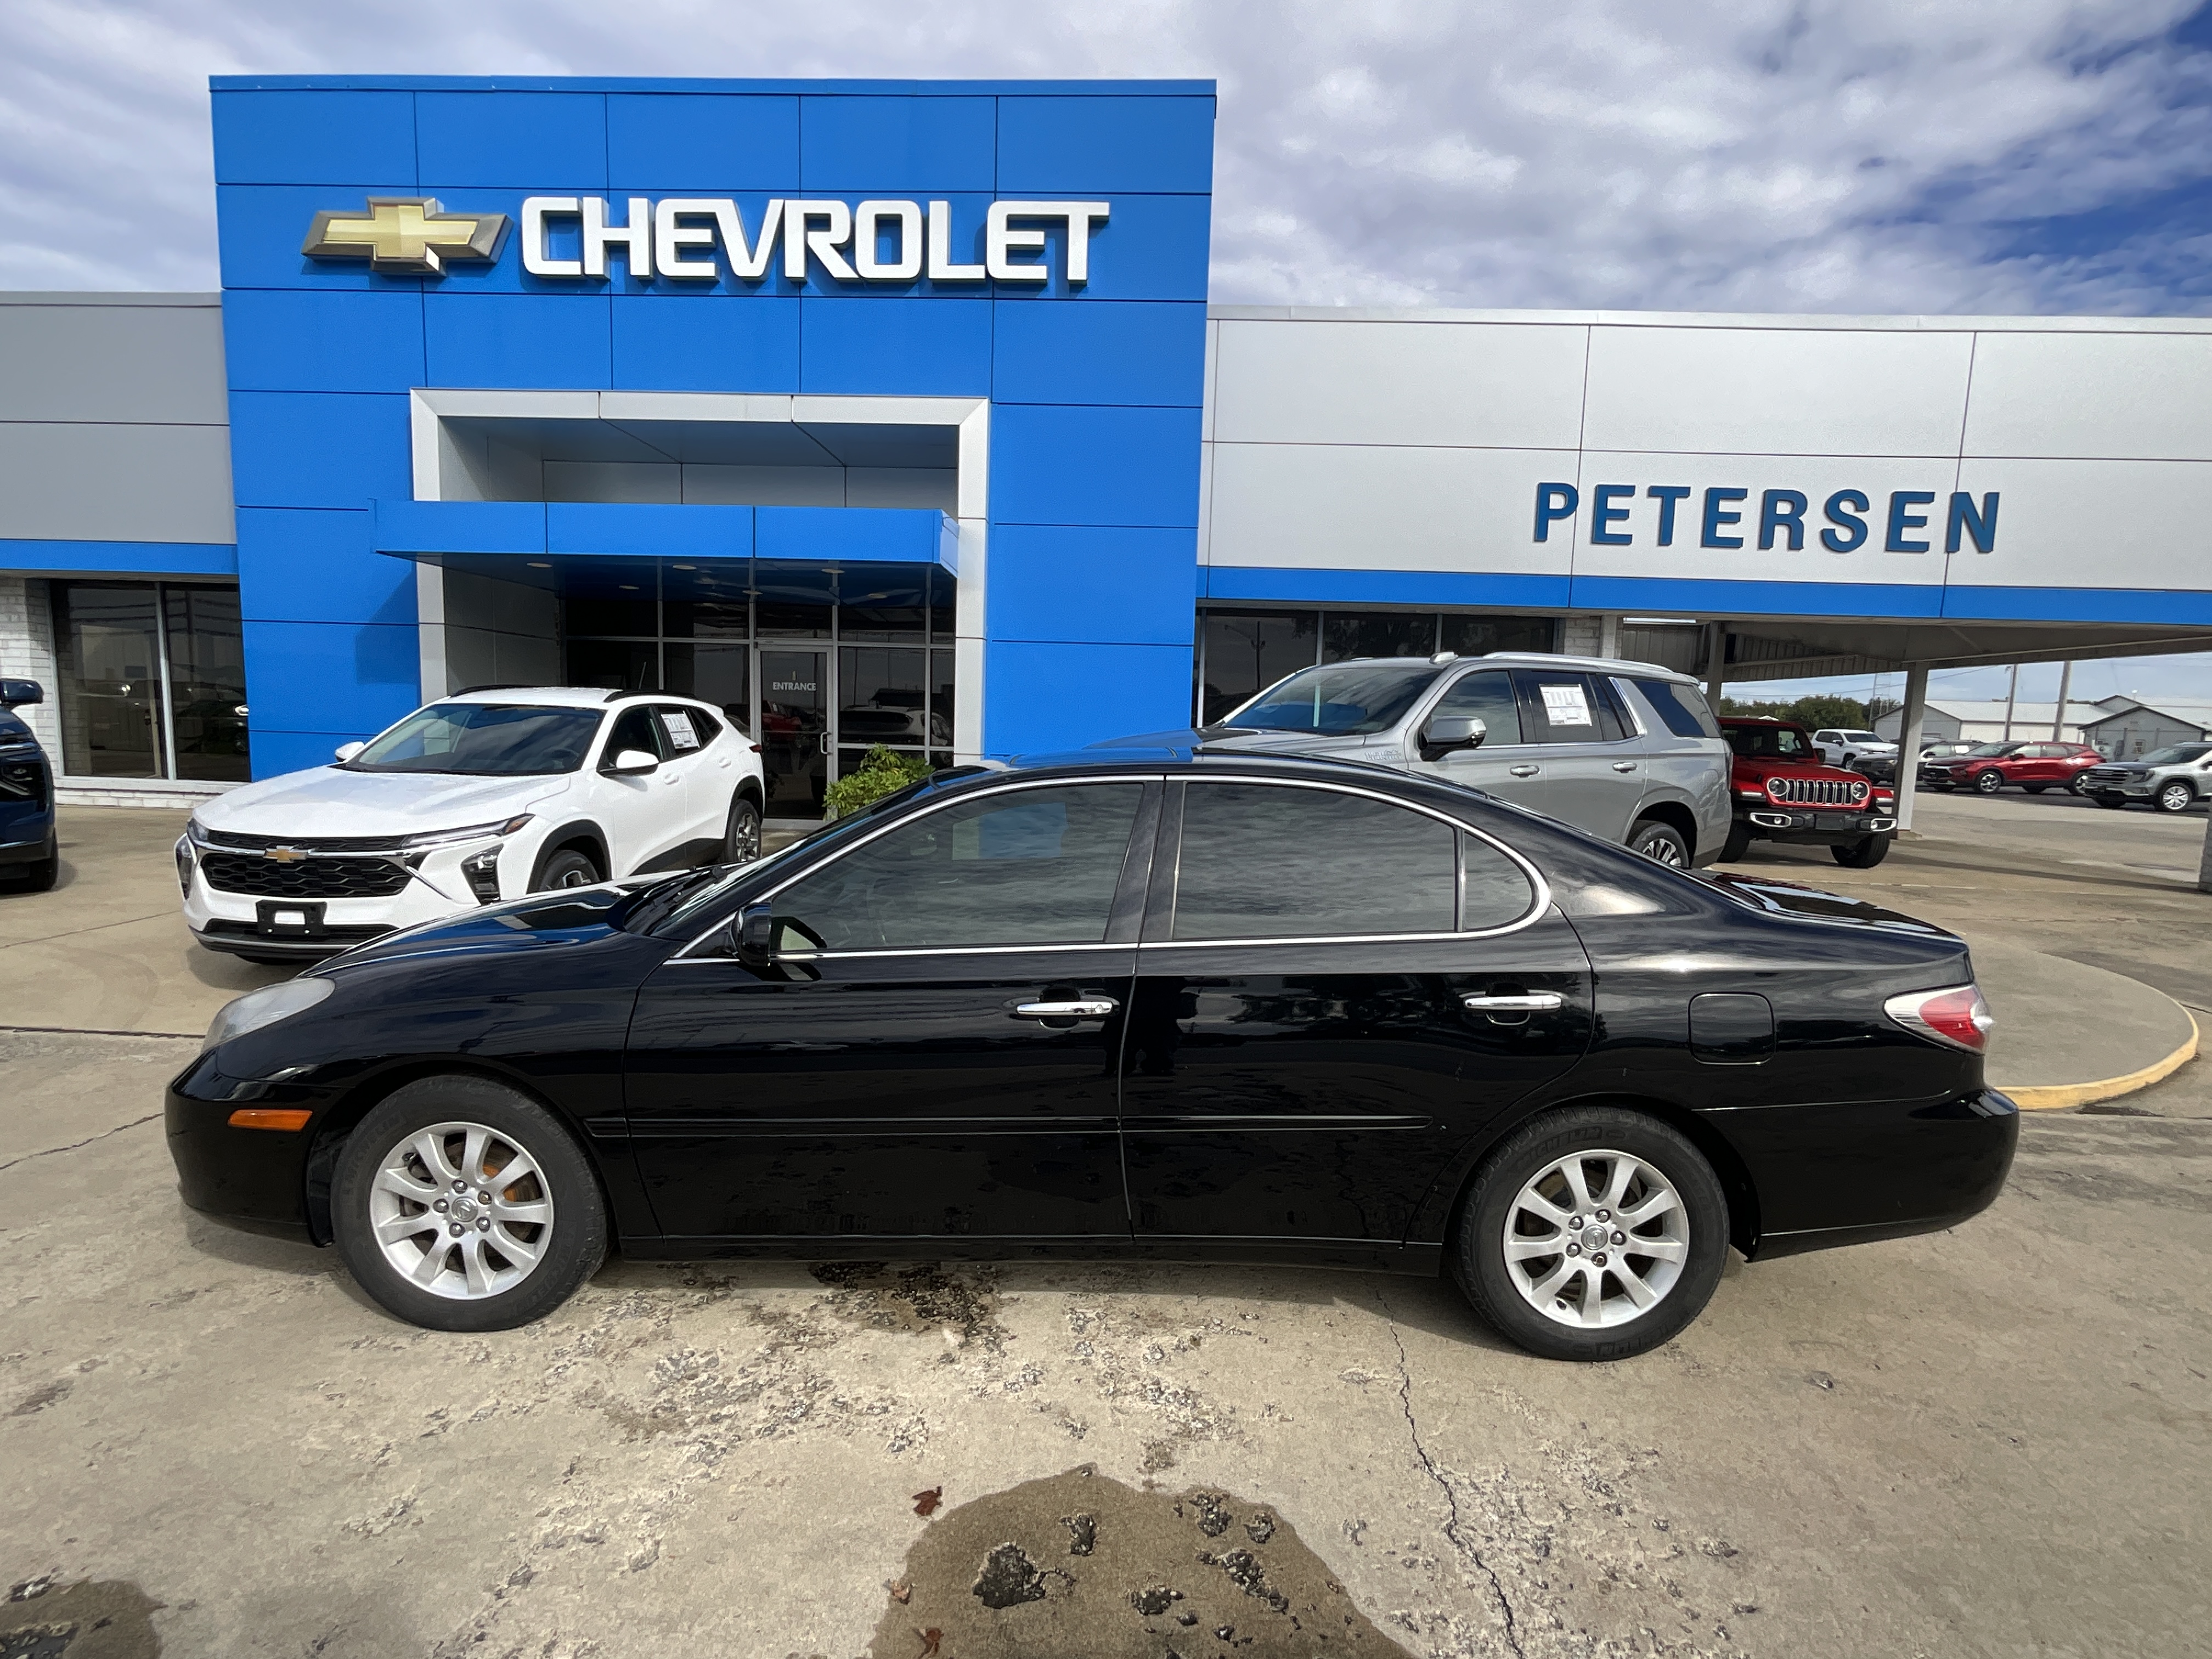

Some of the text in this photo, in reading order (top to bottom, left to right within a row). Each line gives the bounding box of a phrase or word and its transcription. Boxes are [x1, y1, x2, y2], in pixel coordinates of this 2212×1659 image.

[522, 196, 1109, 284] CHEVROLET
[1533, 482, 2000, 553] PETERSEN
[772, 681, 816, 691] ENTRANCE
